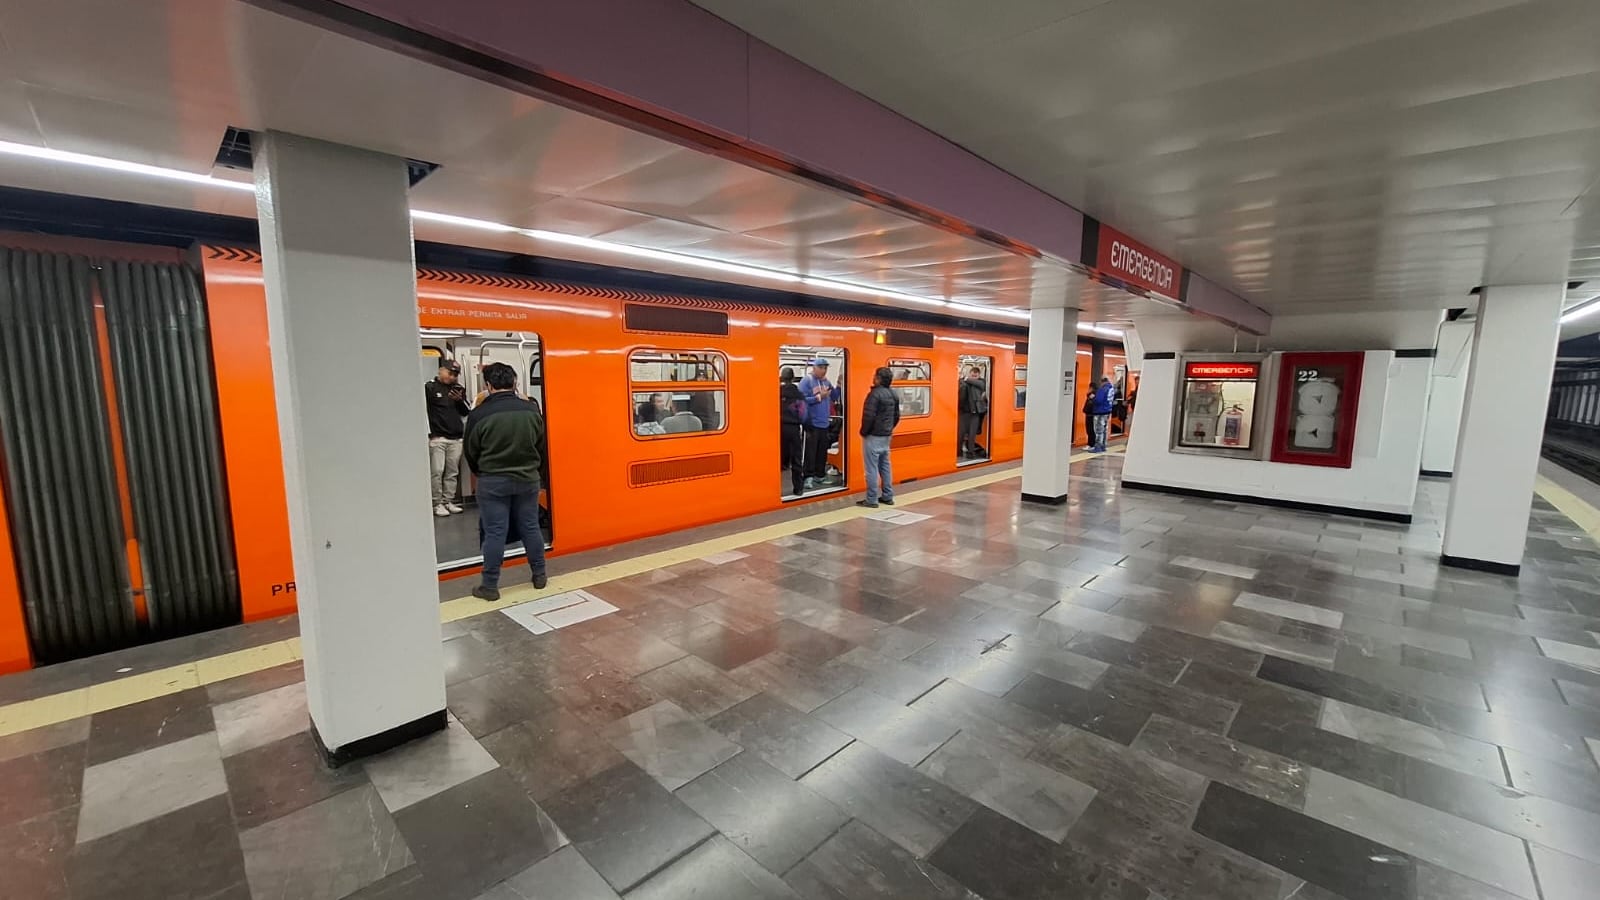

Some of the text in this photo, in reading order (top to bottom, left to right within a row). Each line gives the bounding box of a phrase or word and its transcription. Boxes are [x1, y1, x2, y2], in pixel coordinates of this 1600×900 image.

[1111, 241, 1173, 290] EMERGENCIA
[431, 308, 466, 316] ENTRAR
[468, 310, 502, 318] PERMITA
[505, 312, 528, 320] SALIR
[1192, 366, 1253, 374] EMERGENCIA
[1298, 370, 1318, 382] 22
